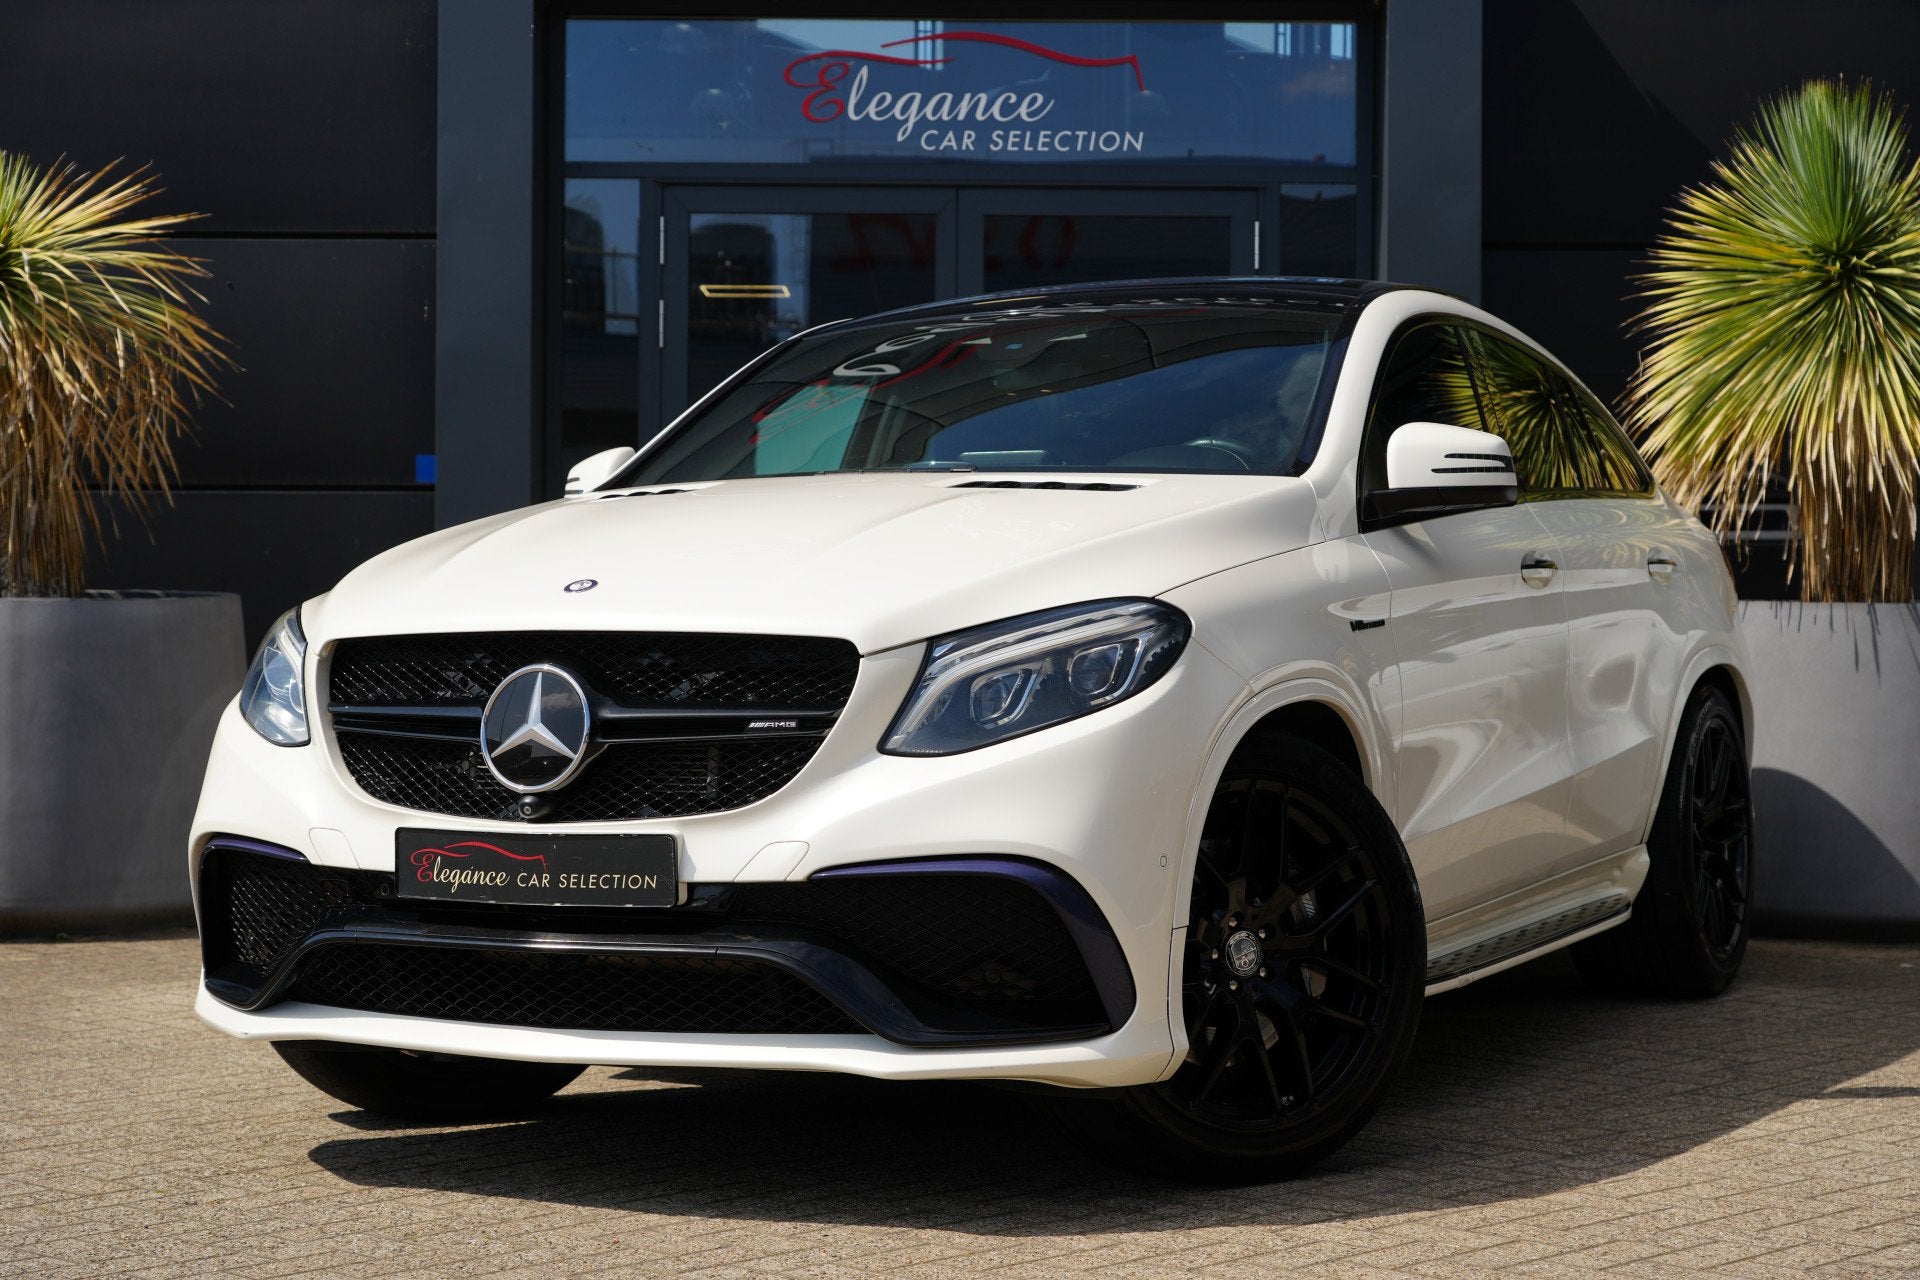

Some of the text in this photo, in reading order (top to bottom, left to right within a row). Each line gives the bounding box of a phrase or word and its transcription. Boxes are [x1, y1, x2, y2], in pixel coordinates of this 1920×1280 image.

[784, 52, 1054, 142] Elegance
[920, 130, 1144, 152] CAR SELECTION
[410, 849, 657, 893] Elegance CAR SELECTION
